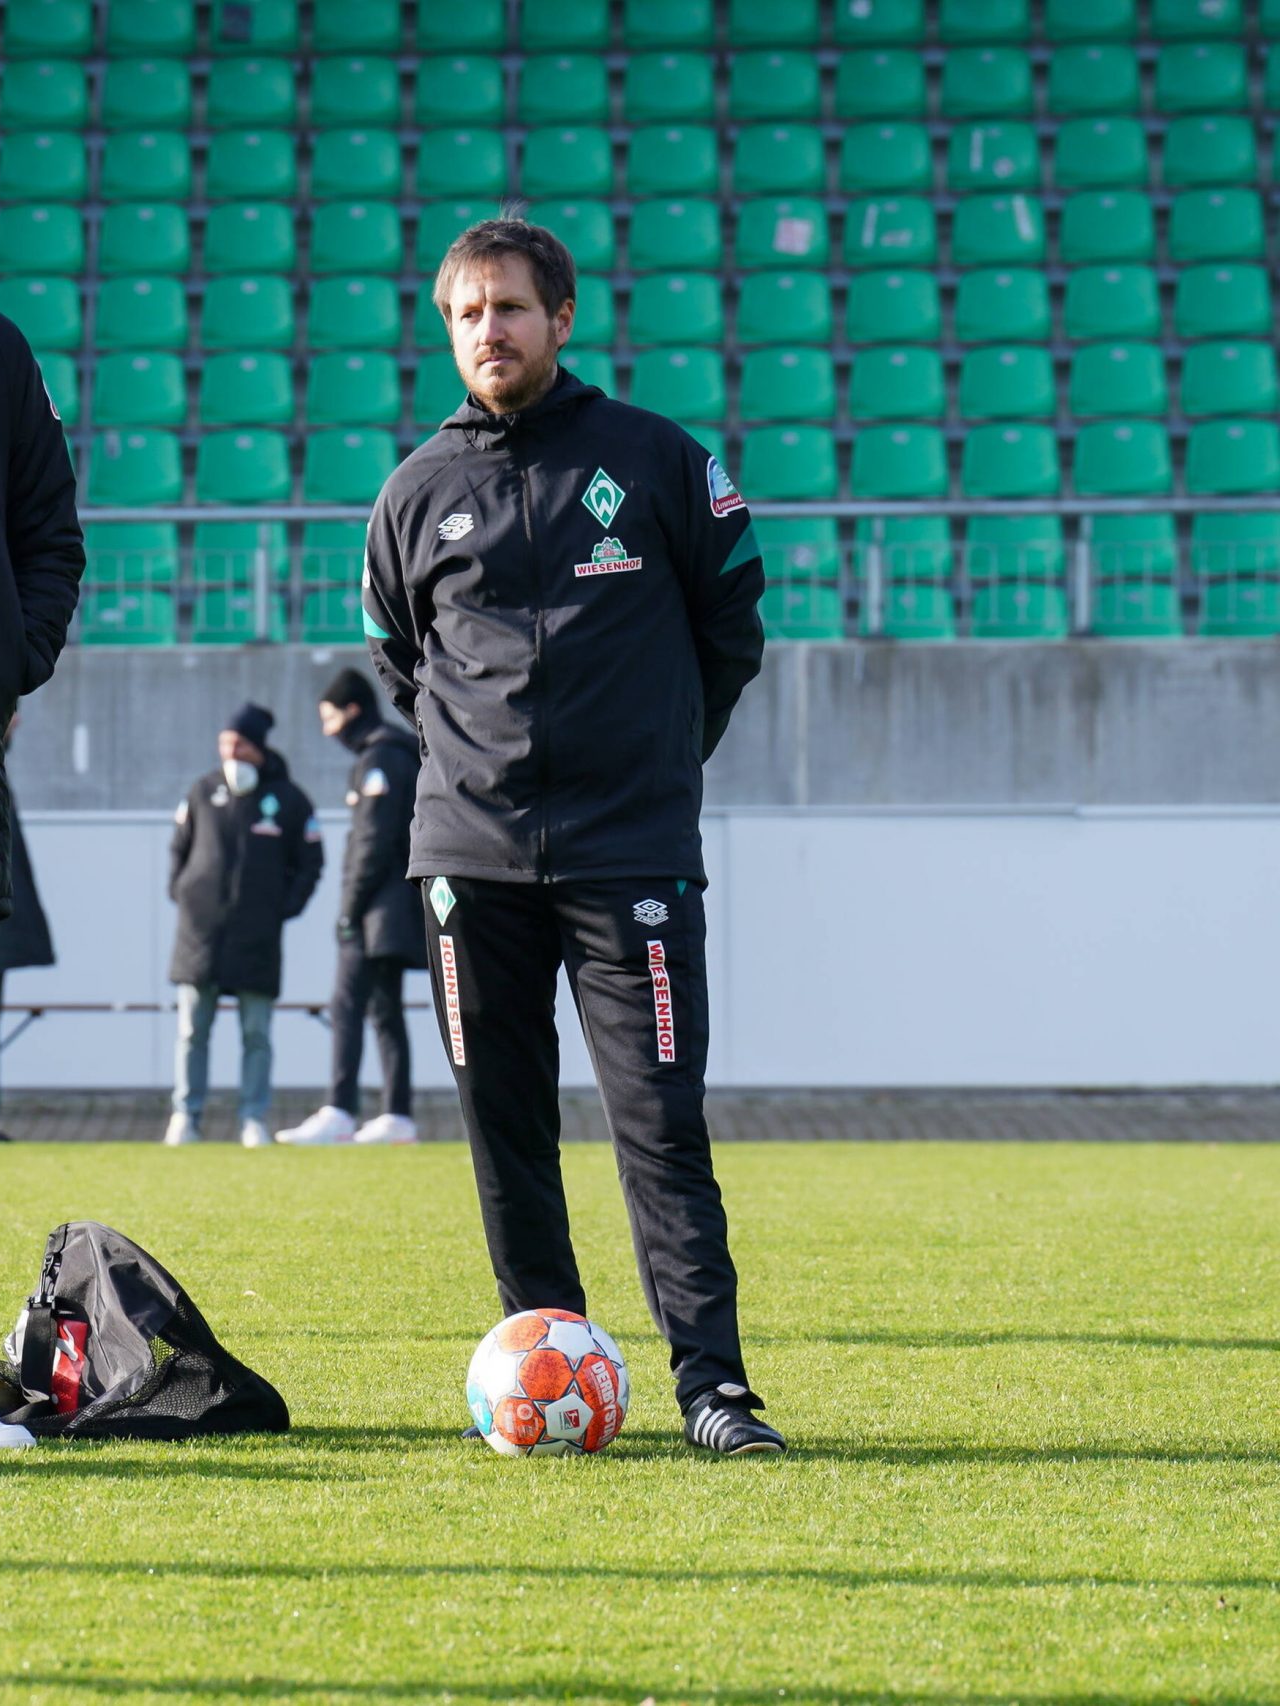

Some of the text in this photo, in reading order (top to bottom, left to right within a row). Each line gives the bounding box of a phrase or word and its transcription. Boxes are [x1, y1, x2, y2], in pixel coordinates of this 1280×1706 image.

[577, 559, 641, 575] WIESENHOF
[442, 938, 464, 1061] WIESENHOF
[649, 942, 674, 1060] WIESENHOF
